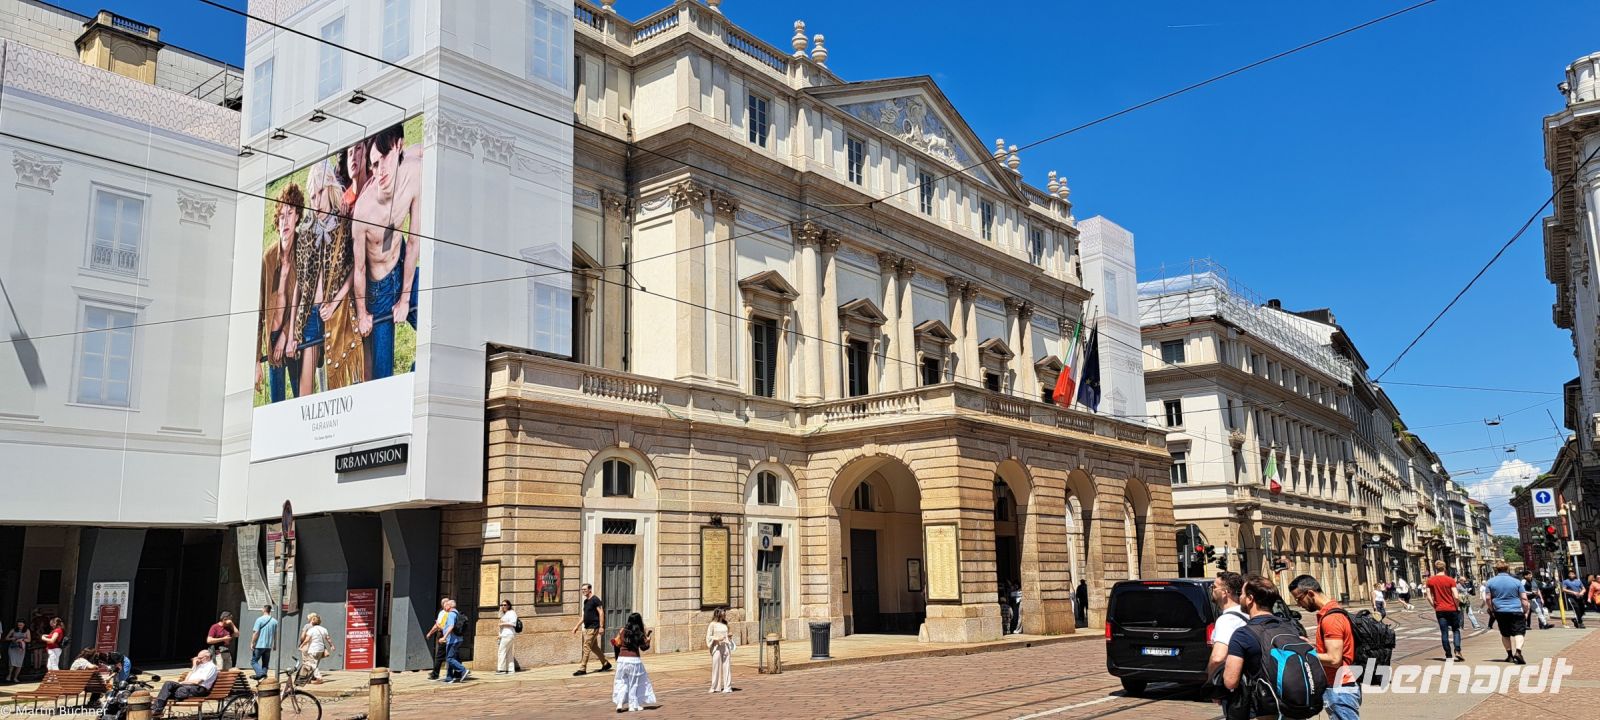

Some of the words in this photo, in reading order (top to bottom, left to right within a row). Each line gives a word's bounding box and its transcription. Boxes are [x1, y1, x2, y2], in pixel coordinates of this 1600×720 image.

[301, 395, 353, 421] VALENTINO
[312, 419, 338, 431] GARAVANI
[336, 455, 367, 470] URBAN
[369, 447, 402, 464] VISION
